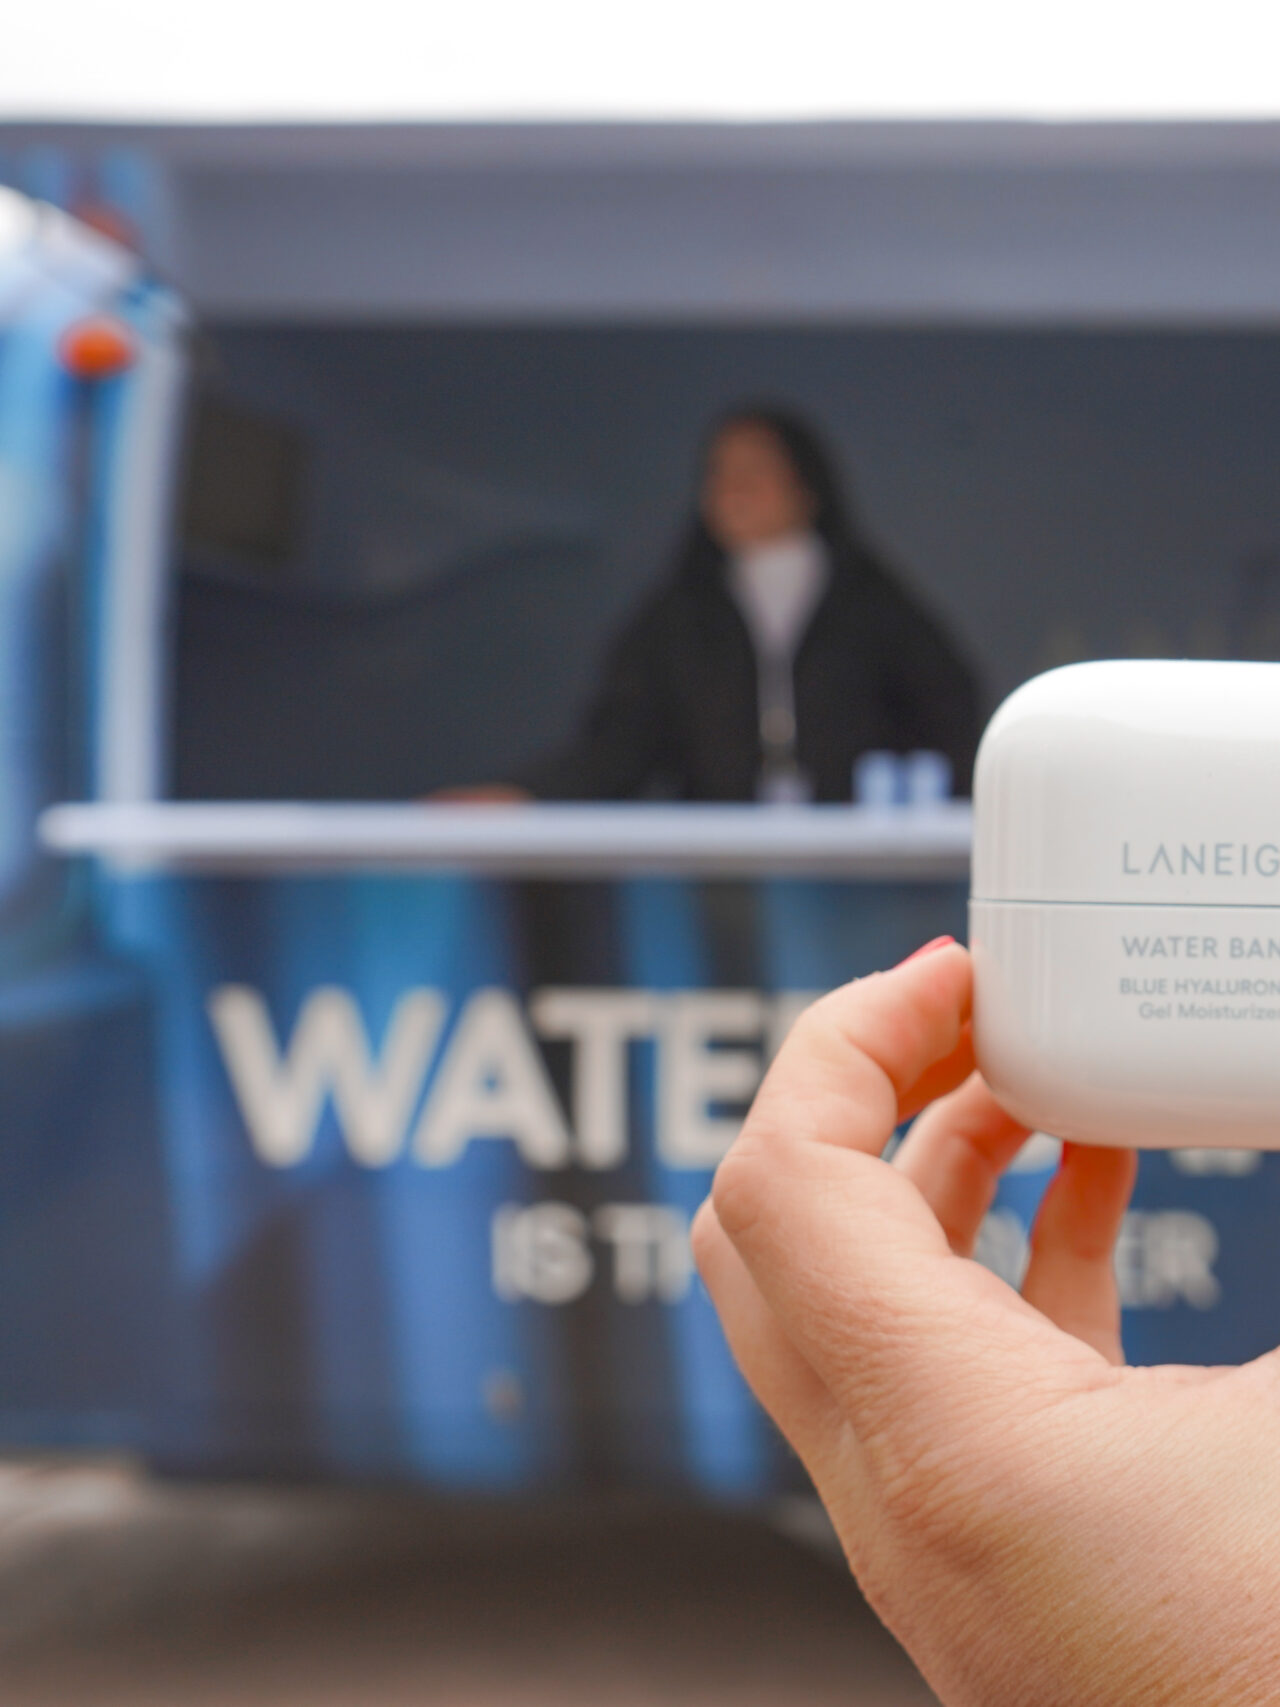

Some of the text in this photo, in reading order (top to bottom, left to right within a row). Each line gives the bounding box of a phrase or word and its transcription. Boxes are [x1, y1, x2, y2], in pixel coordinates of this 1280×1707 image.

[1121, 935, 1219, 959] WATER
[1118, 977, 1169, 996] BLUE
[1138, 1001, 1172, 1020] Gel
[208, 984, 825, 1172] WATE
[492, 1202, 594, 1304] IS
